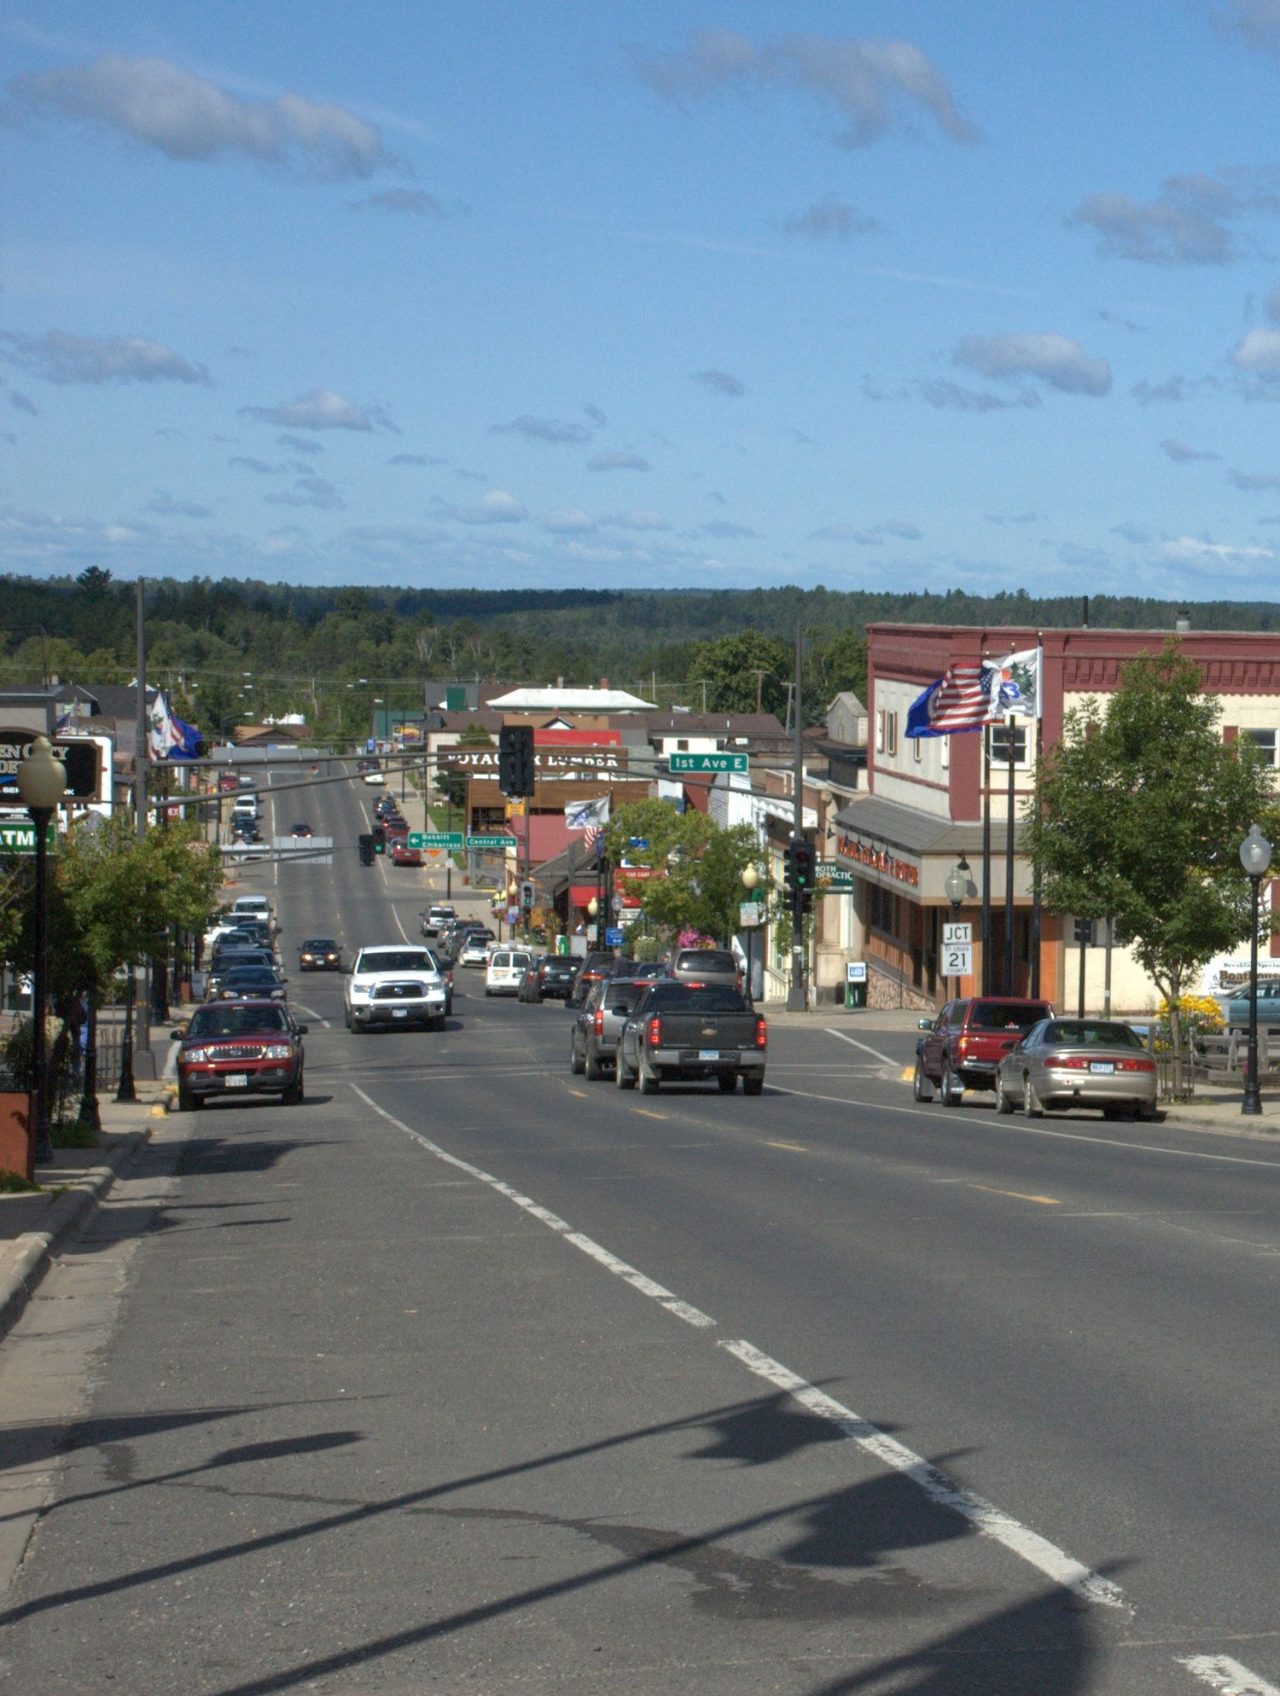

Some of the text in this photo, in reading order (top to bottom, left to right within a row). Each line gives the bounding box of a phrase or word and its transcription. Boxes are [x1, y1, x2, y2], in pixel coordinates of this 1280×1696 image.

[548, 754, 618, 767] LUMBER
[675, 757, 743, 768] 1st Ave E
[0, 830, 34, 847] TM
[469, 838, 514, 846] Central Ave
[946, 926, 969, 940] JCT
[949, 952, 966, 967] 21
